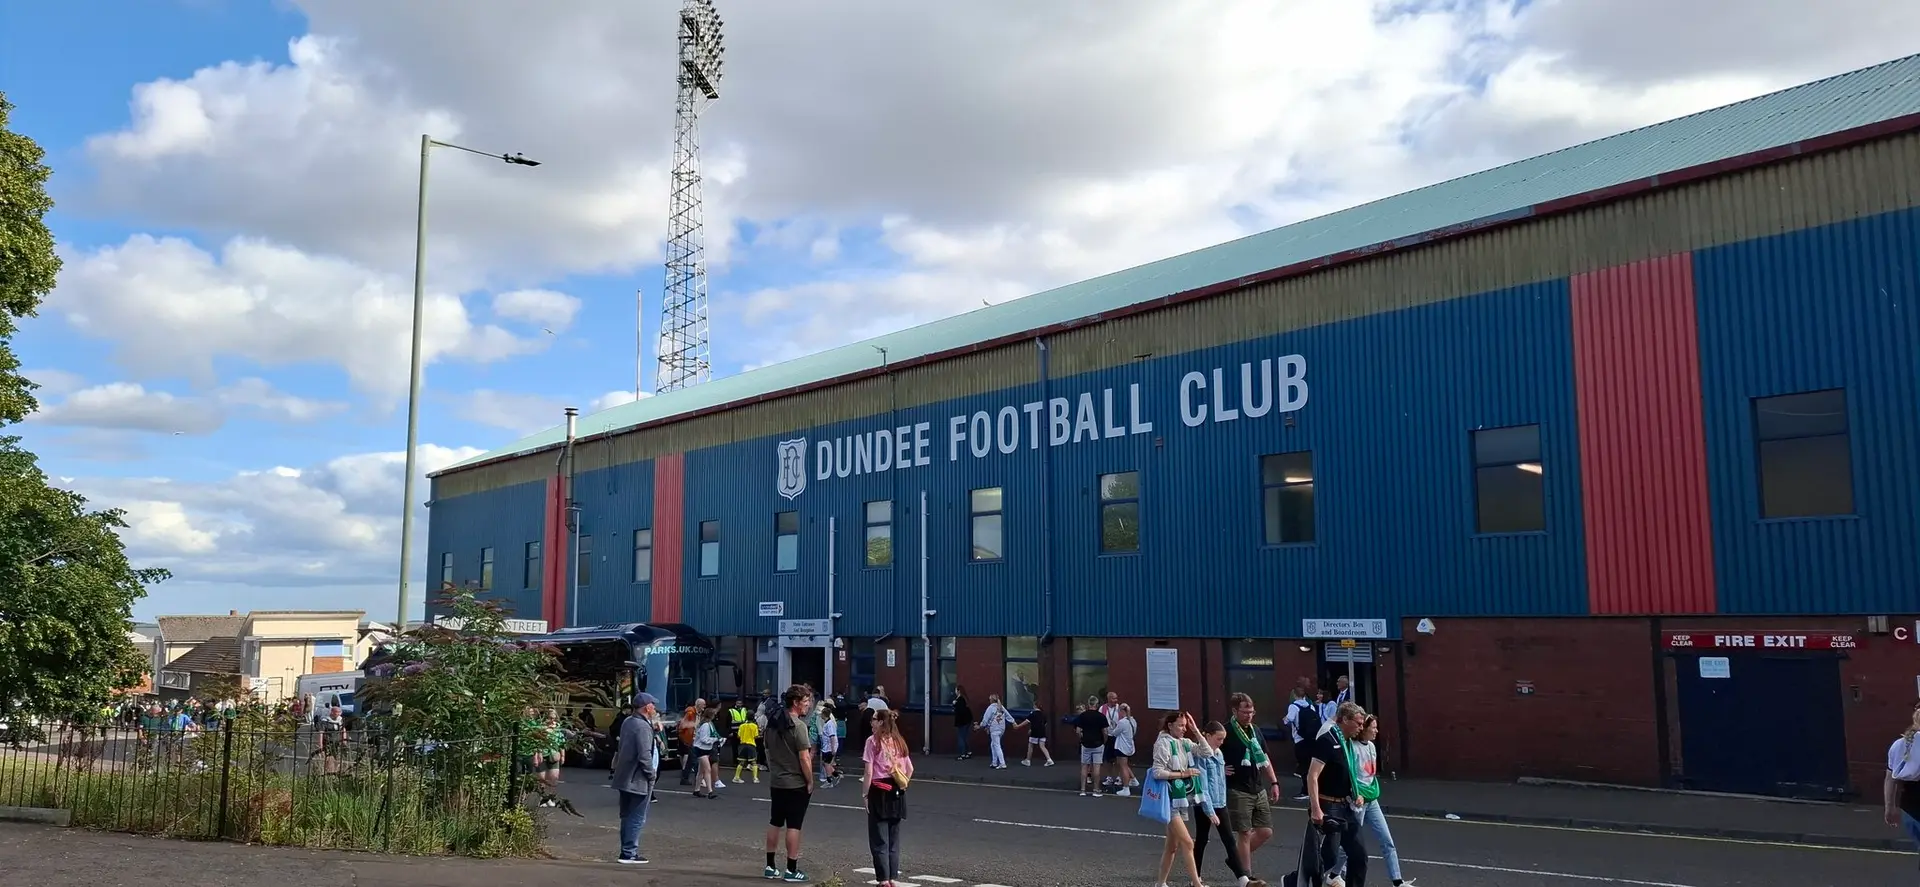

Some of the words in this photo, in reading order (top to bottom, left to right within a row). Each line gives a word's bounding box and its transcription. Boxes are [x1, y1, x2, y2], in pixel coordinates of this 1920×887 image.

[816, 421, 931, 481] DUNDEE
[950, 382, 1153, 461] FOOTBALL
[1180, 353, 1309, 428] CLUB
[506, 620, 543, 632] STREET
[1714, 635, 1756, 647] FIRE
[1763, 635, 1807, 647] EXIT
